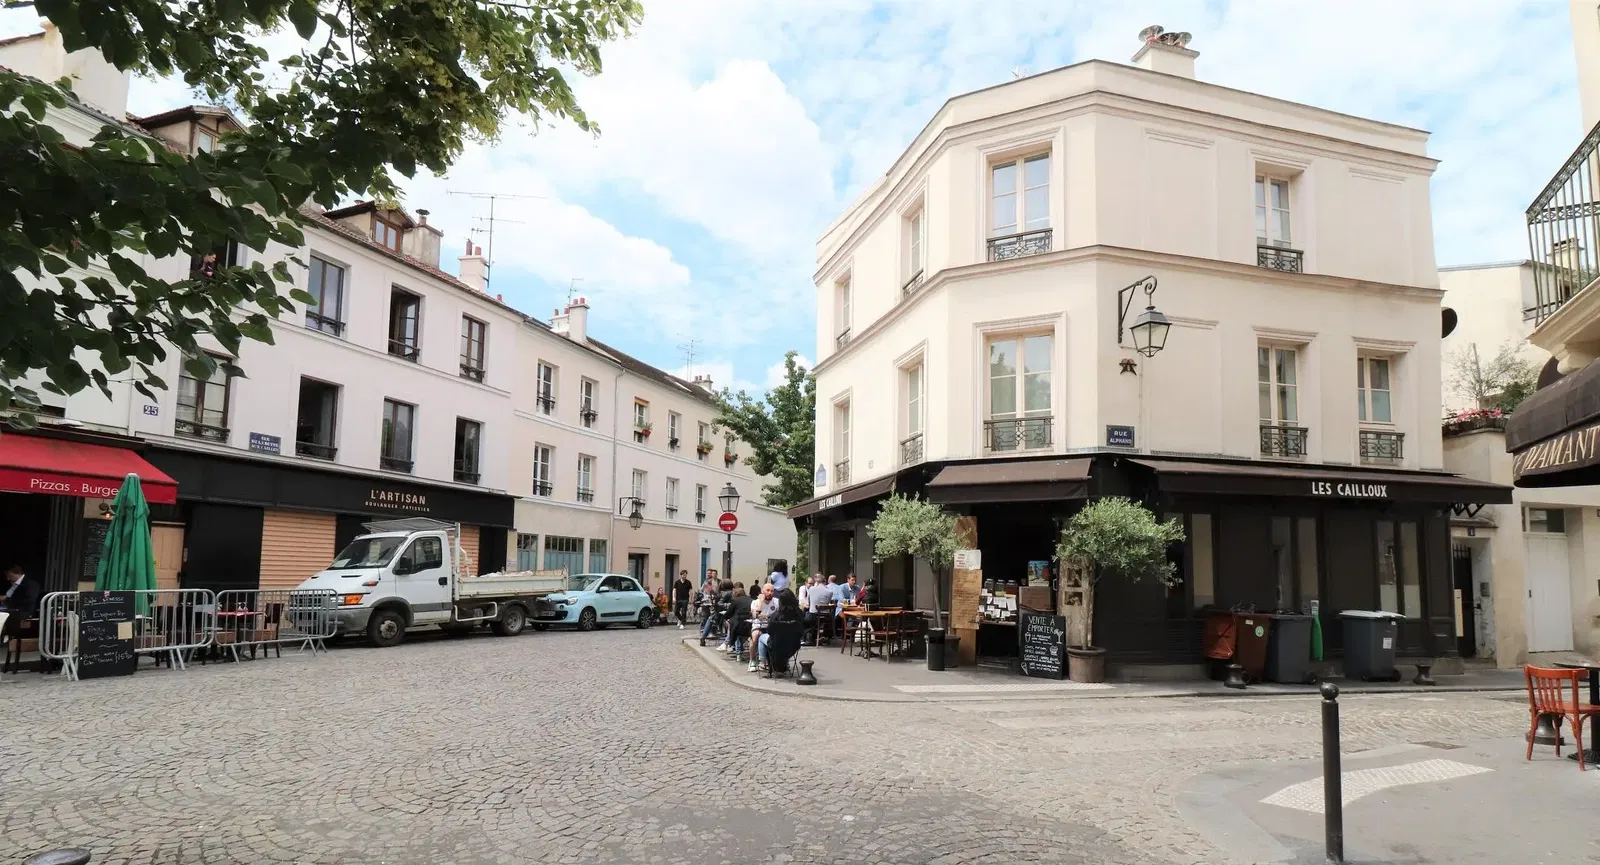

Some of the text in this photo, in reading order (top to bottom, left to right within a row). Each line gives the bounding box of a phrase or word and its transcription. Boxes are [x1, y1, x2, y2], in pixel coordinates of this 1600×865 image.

[144, 405, 158, 416] 25
[1519, 425, 1600, 474] DIAMANT
[30, 478, 120, 497] Pizzas Burge
[1312, 481, 1388, 498] LES CAILLOUX
[371, 490, 426, 505] L'ARTISAN
[365, 501, 398, 509] BOULANGER
[1028, 615, 1046, 625] VENTE
[1027, 624, 1054, 634] EMPORTER
